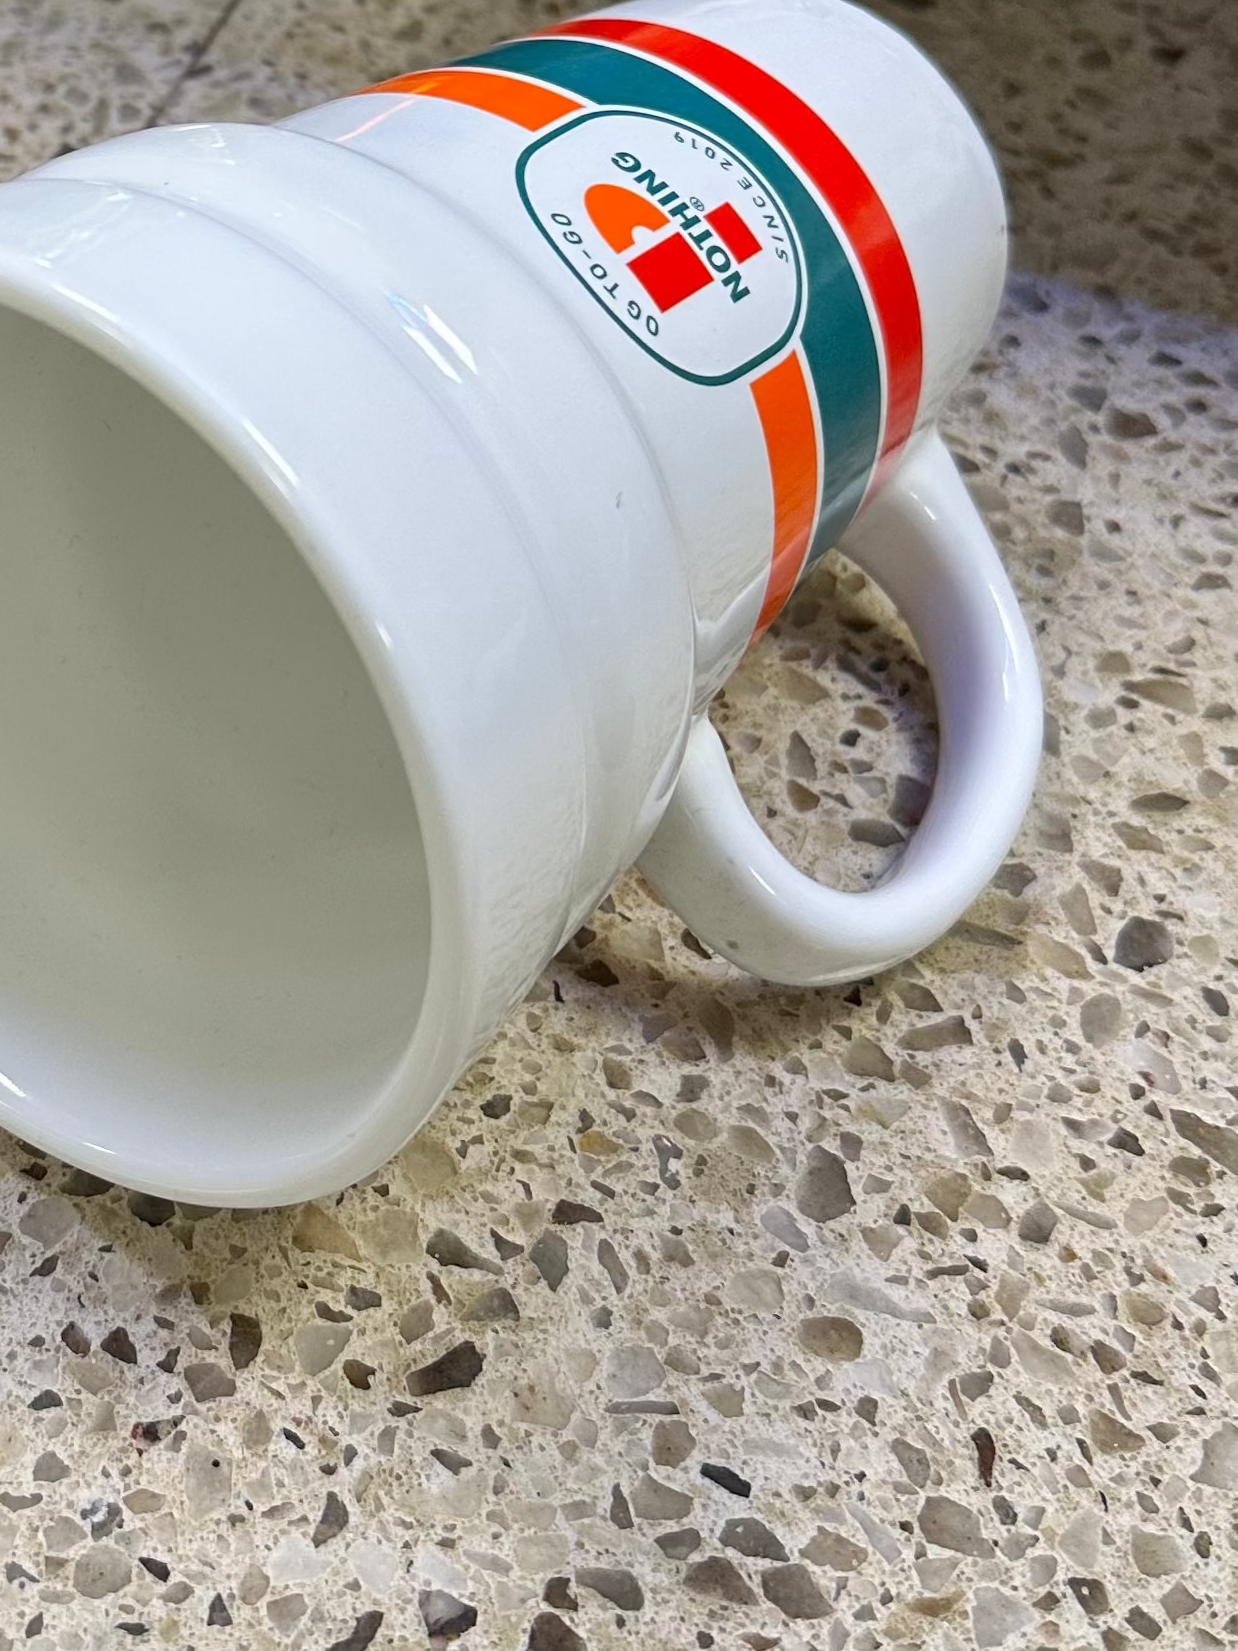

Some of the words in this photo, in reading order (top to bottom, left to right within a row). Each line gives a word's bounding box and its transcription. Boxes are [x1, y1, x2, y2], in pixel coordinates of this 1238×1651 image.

[673, 131, 734, 171] 2019
[551, 213, 620, 301] TO-GO
[611, 152, 751, 304] NOTHING
[736, 176, 790, 264] SINCE
[626, 300, 660, 337] OG
